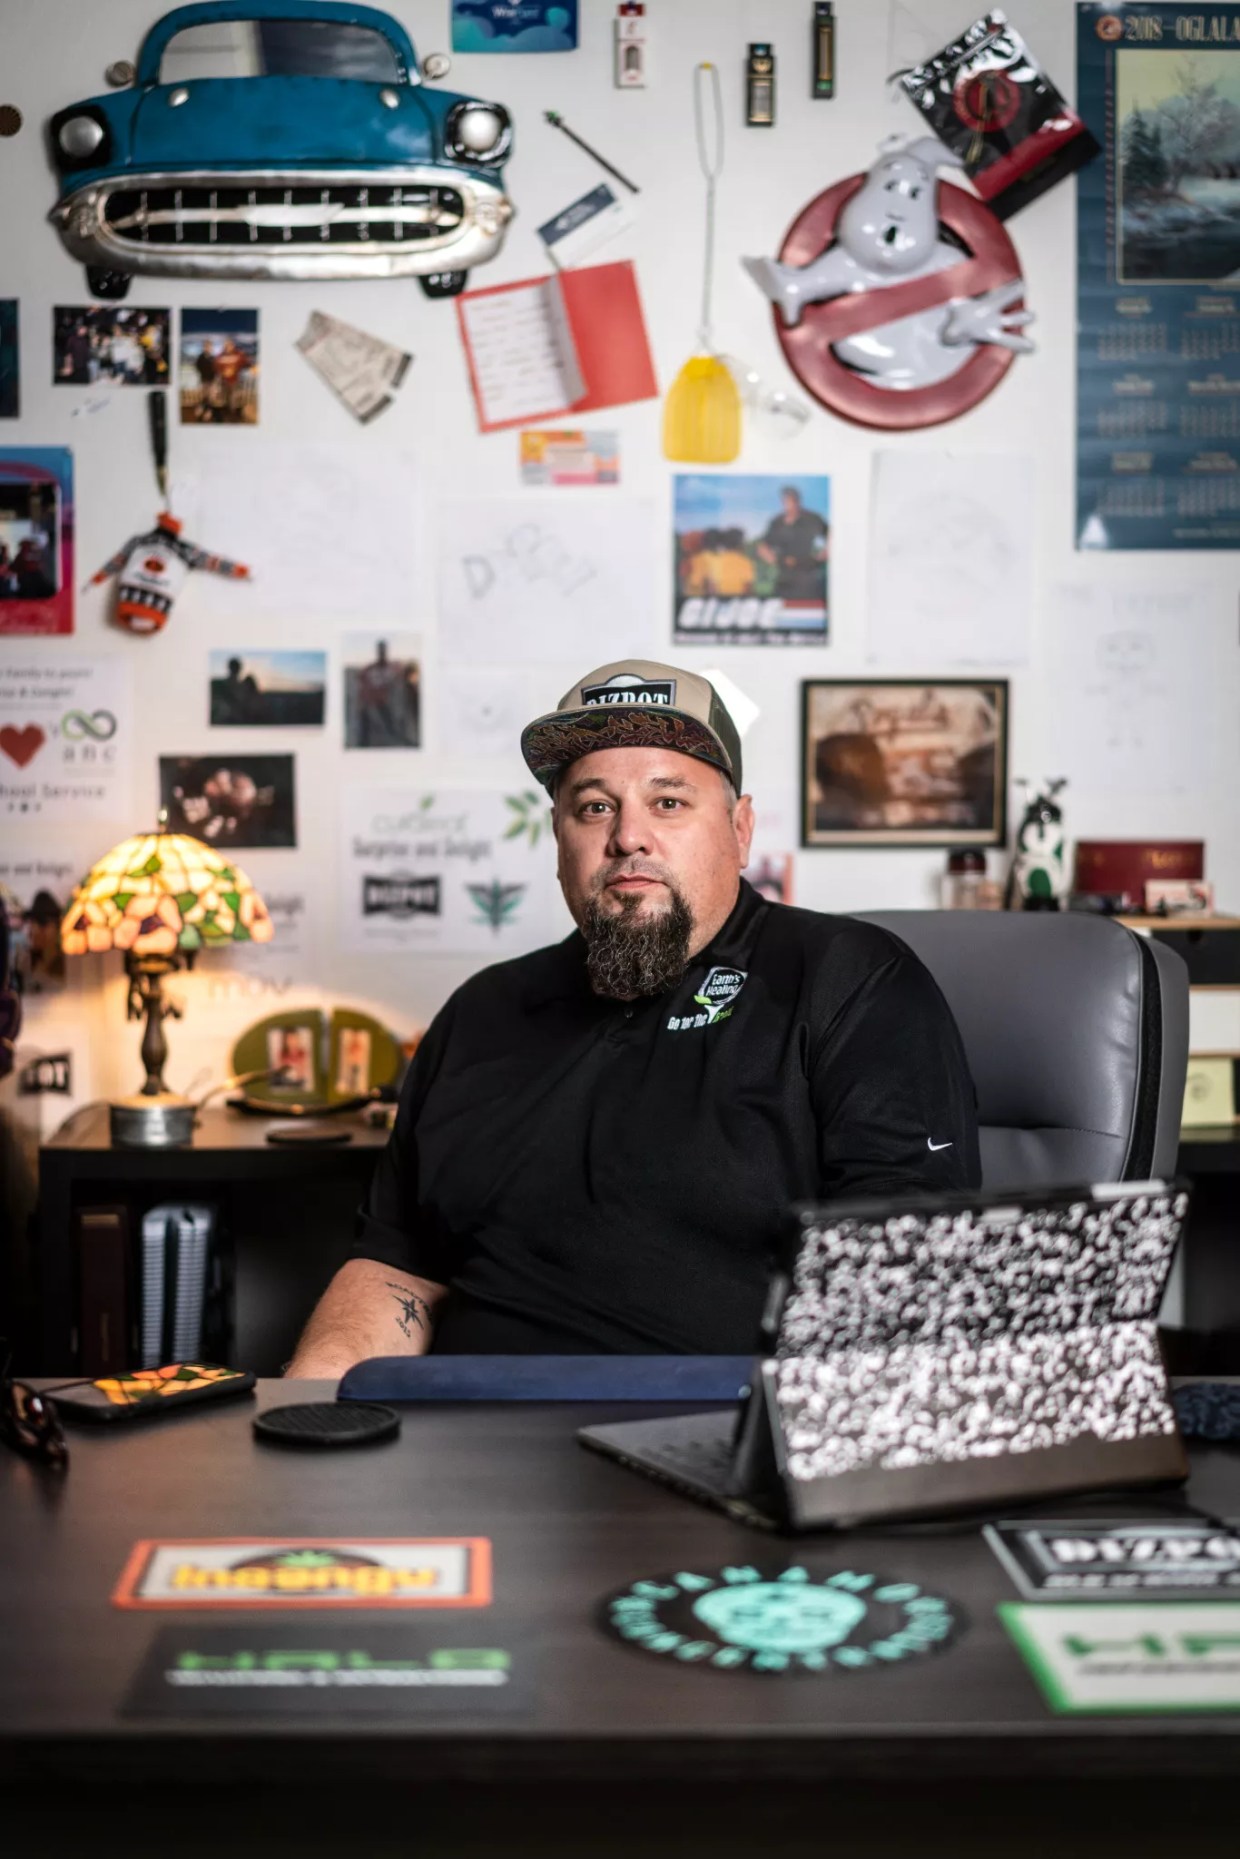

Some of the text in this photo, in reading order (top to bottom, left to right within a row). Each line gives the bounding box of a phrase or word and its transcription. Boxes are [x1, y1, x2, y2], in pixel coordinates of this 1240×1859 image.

[712, 974, 742, 986] Earth's
[706, 984, 739, 997] Healing
[667, 1016, 681, 1031] Go
[680, 1016, 695, 1030] for
[693, 1013, 709, 1028] the
